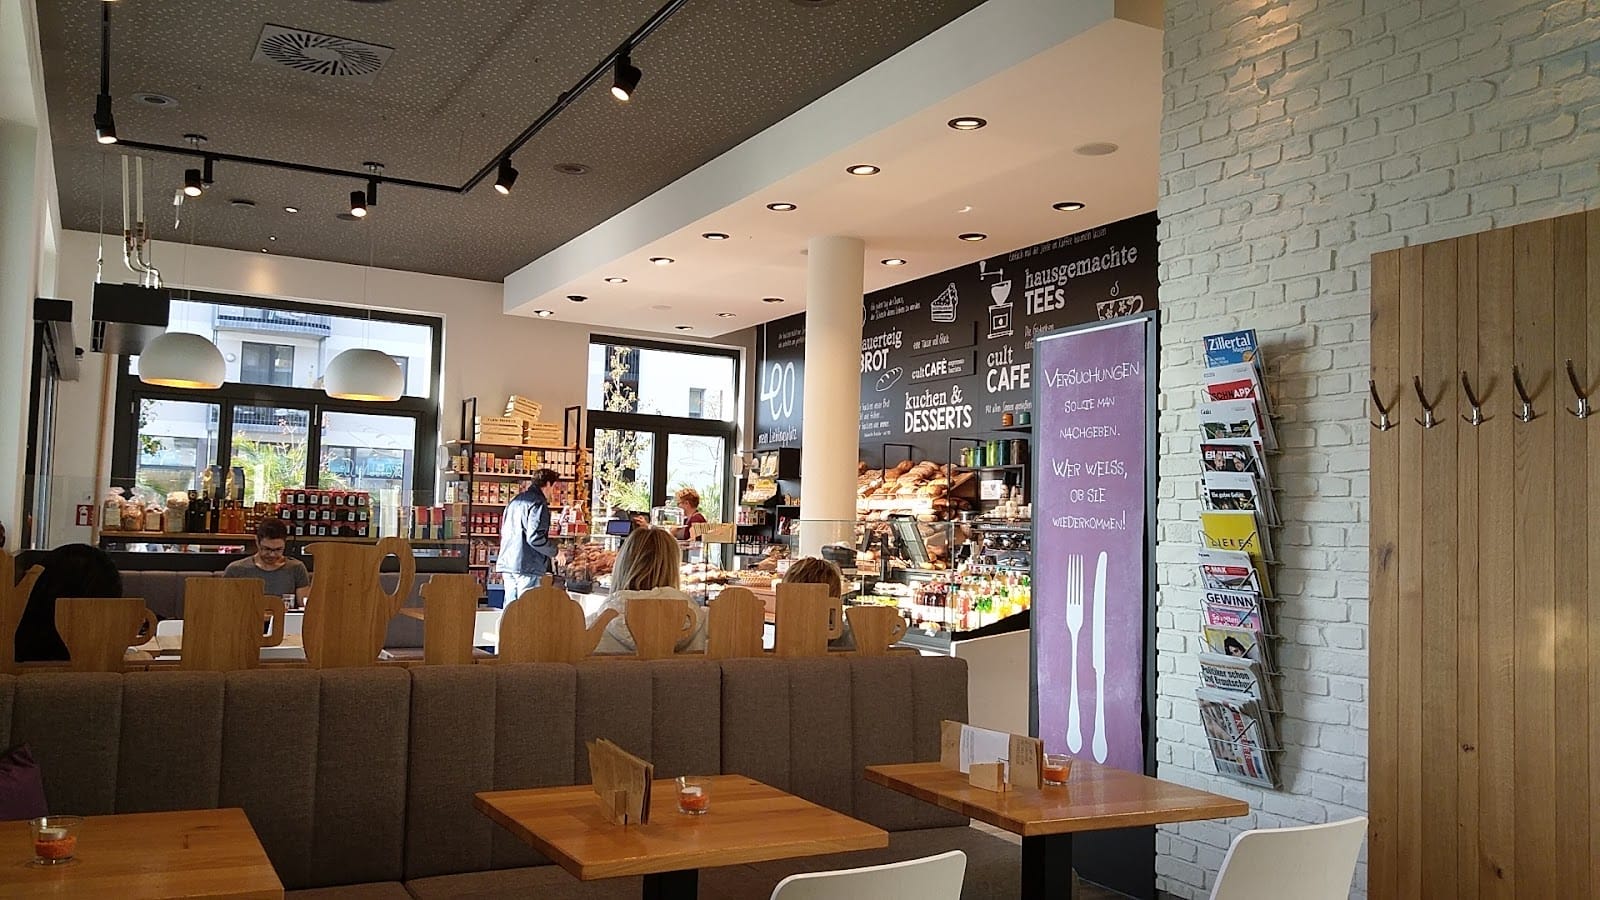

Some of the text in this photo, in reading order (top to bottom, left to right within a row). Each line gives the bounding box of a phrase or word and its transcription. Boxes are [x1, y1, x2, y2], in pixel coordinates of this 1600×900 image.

[1025, 245, 1138, 289] hausgemachte
[1025, 285, 1065, 315] TEES
[862, 326, 902, 348] auerteig
[1208, 333, 1252, 351] Zillertal
[987, 344, 1013, 367] cult
[1044, 360, 1139, 388] VERSUCHUNGEN
[904, 389, 947, 410] kuchen
[951, 384, 963, 404] &
[1097, 396, 1115, 409] MAN
[904, 404, 973, 433] DESSERTS
[1059, 425, 1121, 440] NACHGEBEN.
[1051, 458, 1128, 480] WER WEISS,
[1070, 487, 1106, 503] OB SIE
[1052, 510, 1126, 530] WIEDERKOMMEN!
[1206, 592, 1254, 607] GEWINN
